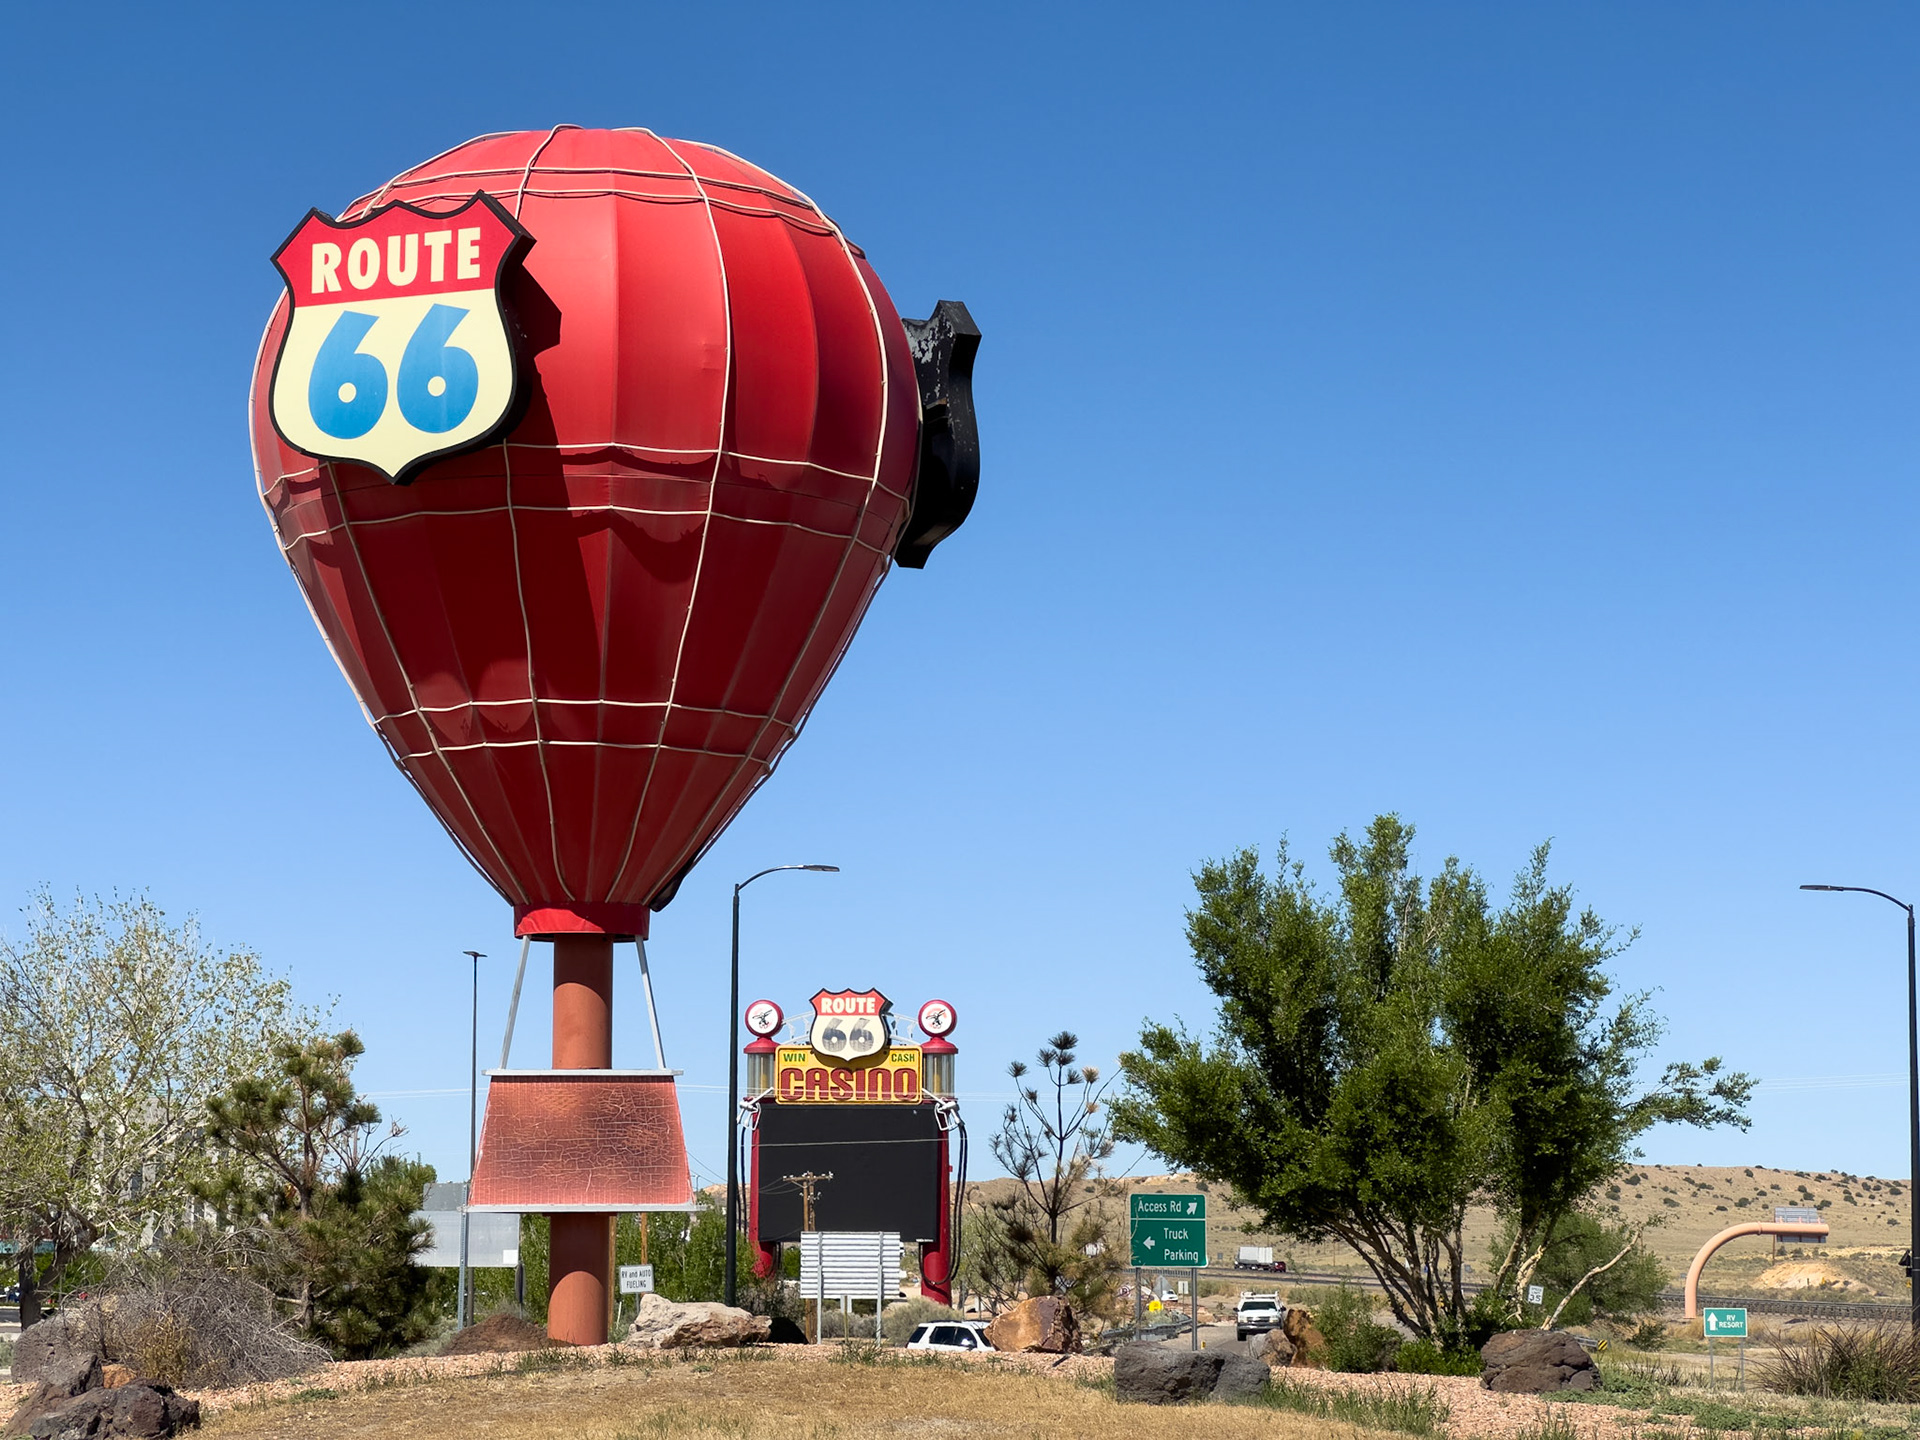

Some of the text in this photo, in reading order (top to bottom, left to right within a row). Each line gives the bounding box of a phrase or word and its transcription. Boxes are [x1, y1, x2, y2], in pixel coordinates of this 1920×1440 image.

[311, 227, 481, 294] ROUTE
[308, 303, 479, 440] 66
[821, 998, 875, 1013] ROUTE
[822, 1018, 874, 1052] 66
[783, 1053, 915, 1062] WIN CASH
[780, 1067, 918, 1101] CASINO
[1138, 1200, 1182, 1213] Access Rd
[1163, 1227, 1189, 1240] Truck
[1164, 1248, 1199, 1264] Parking
[639, 1270, 651, 1278] AUTO
[626, 1280, 646, 1288] FUELING
